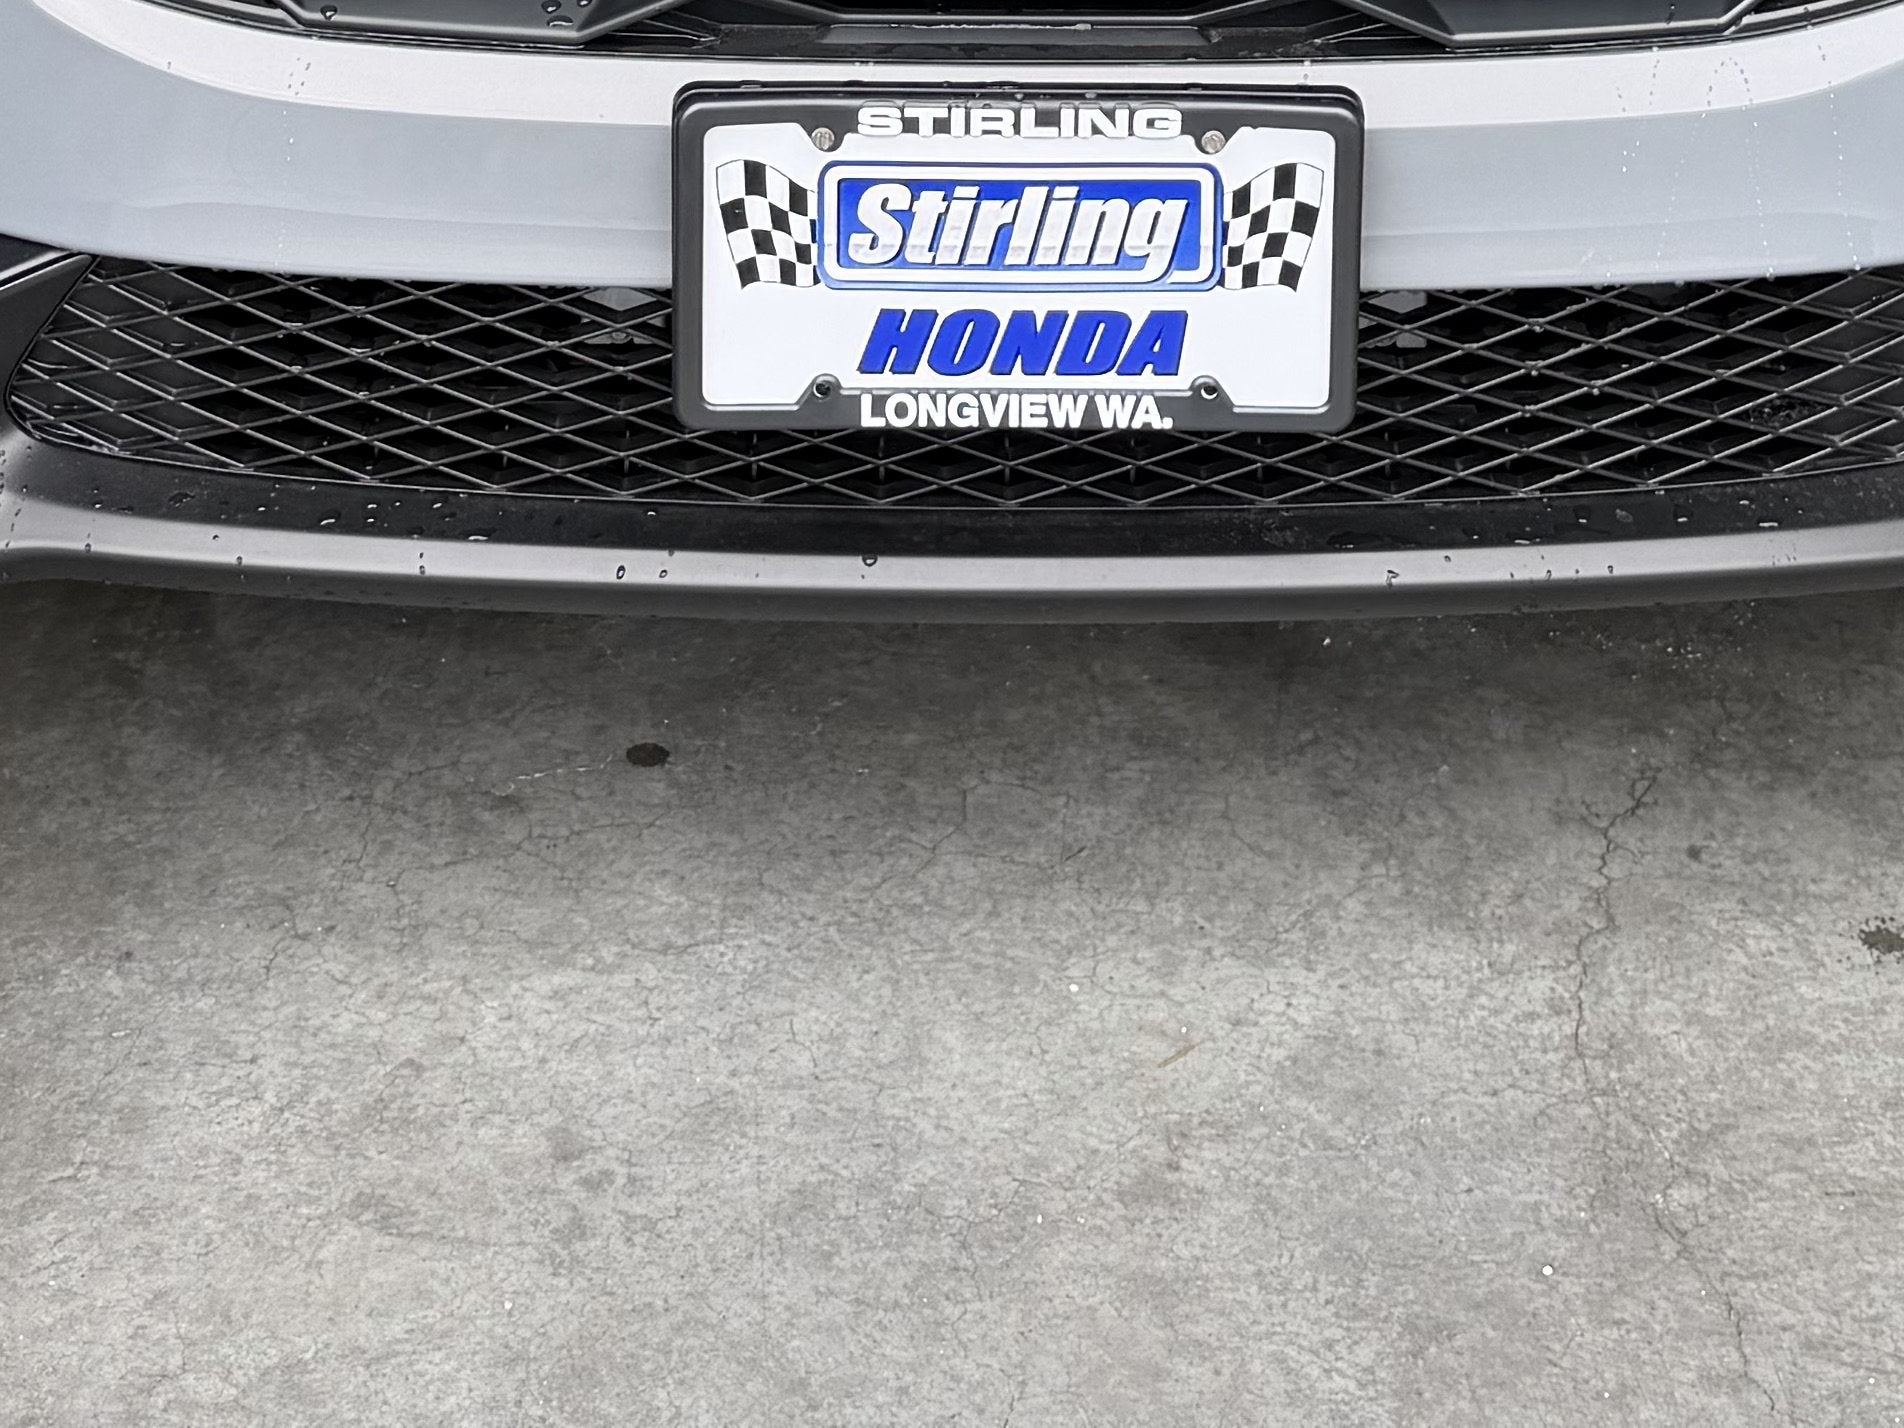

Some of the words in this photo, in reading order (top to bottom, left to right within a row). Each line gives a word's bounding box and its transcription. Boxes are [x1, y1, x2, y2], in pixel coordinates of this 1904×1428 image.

[857, 106, 1183, 138] STIRLING
[847, 182, 1189, 283] Stirling
[855, 307, 1189, 376] HONDA
[859, 392, 1088, 429] LONGVIEW
[1094, 393, 1174, 430] WA.
